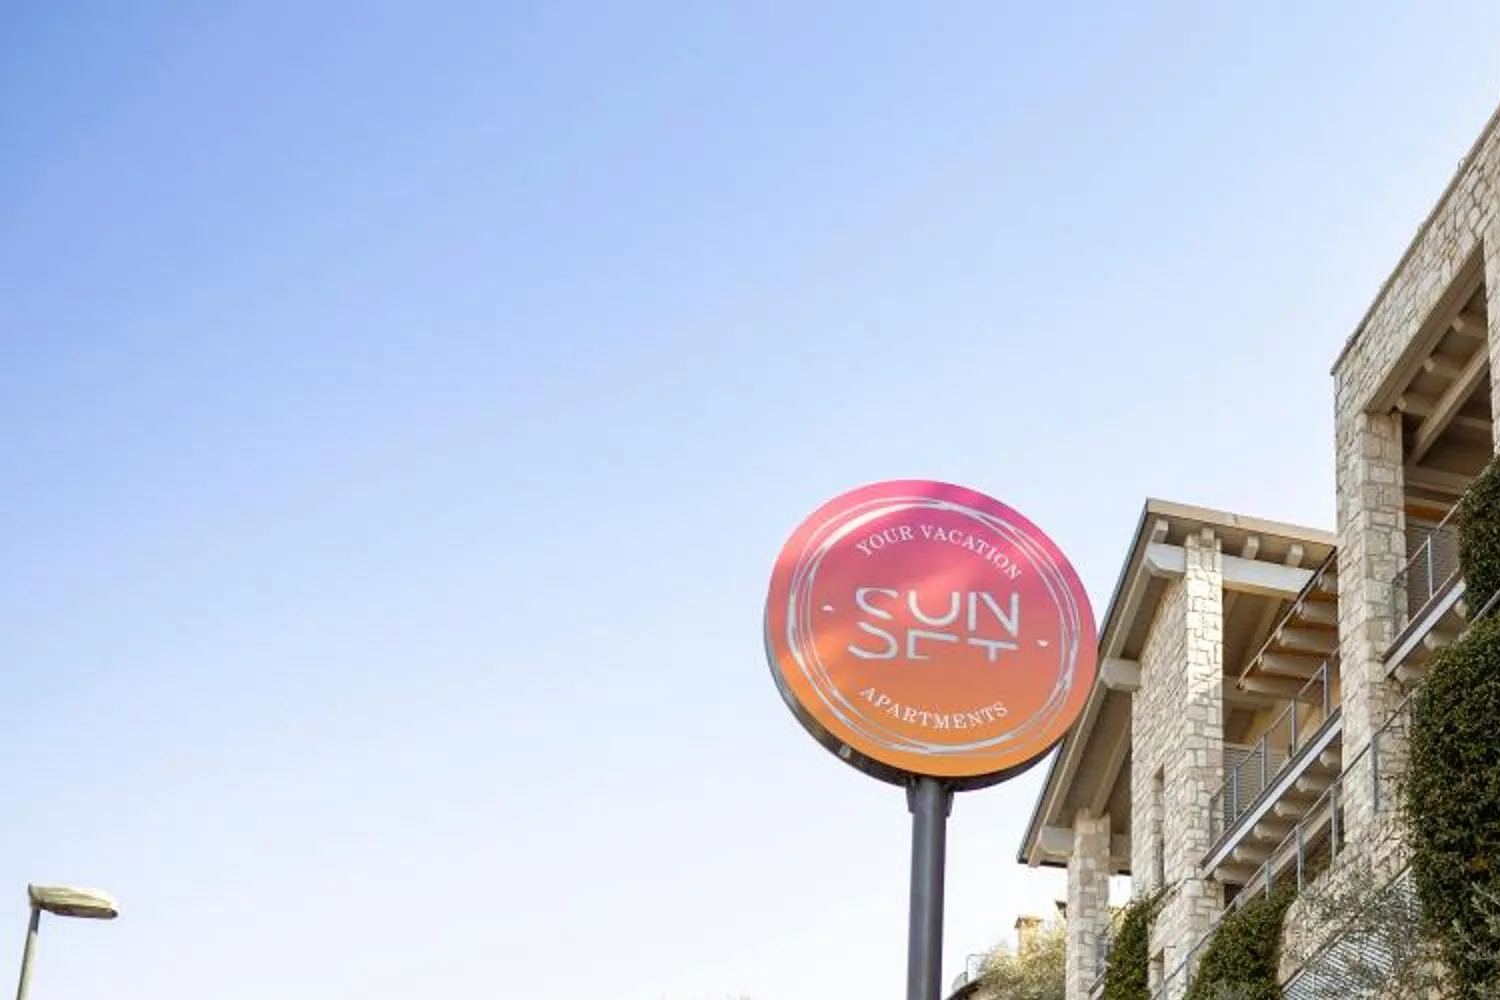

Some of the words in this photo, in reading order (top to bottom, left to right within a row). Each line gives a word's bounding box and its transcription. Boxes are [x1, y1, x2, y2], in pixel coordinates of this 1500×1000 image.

[856, 525, 913, 556] YOUR
[920, 524, 1022, 580] VACATION
[855, 586, 1019, 637] SUN
[858, 687, 1008, 729] APARTMENTS
